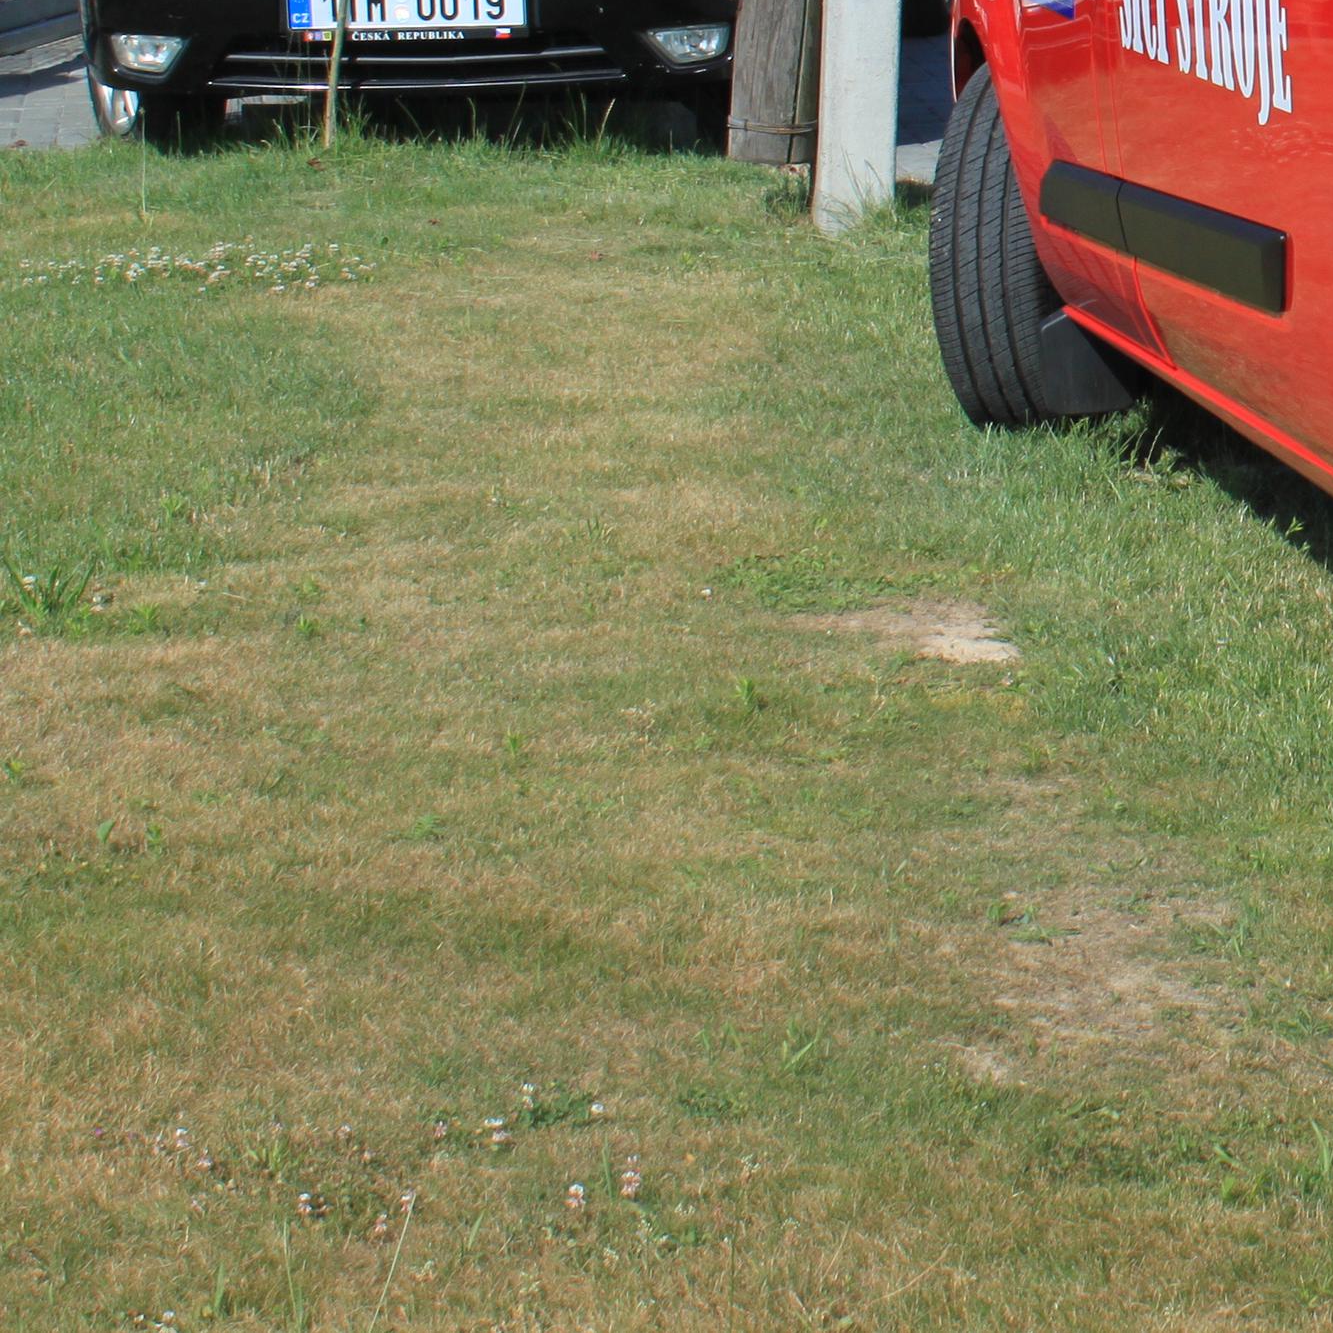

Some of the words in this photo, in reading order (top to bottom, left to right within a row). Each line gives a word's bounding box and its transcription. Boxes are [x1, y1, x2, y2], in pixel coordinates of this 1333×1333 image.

[292, 13, 309, 24] CZ
[351, 29, 390, 41] ČESKÁ
[397, 31, 465, 41] REPUBLIKA
